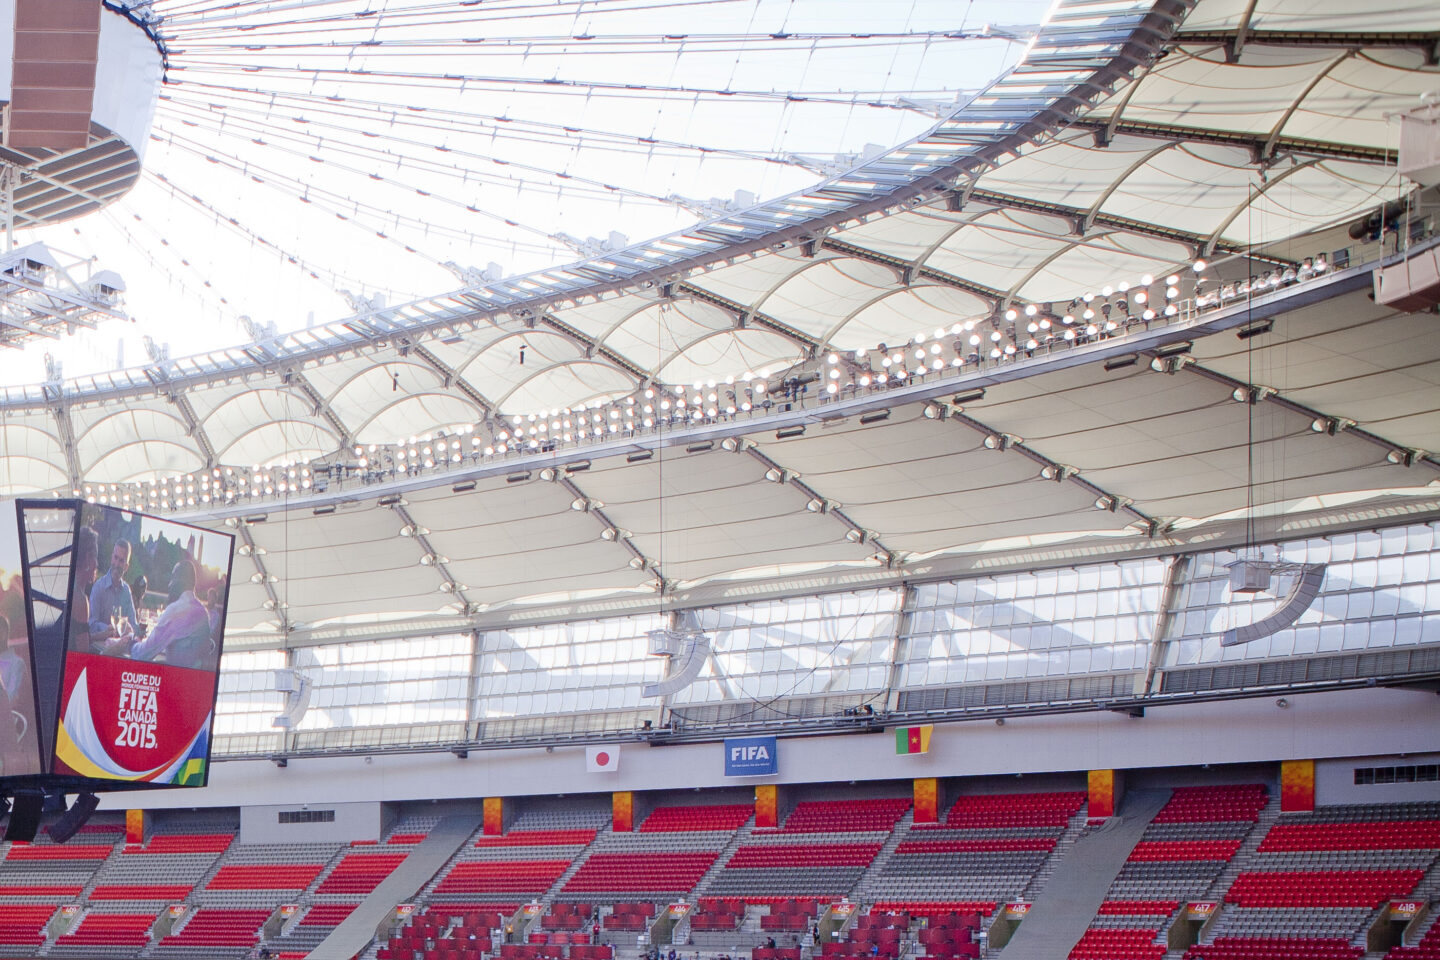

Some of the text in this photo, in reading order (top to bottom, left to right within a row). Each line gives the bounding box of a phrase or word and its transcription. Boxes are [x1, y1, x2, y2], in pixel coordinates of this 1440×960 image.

[122, 672, 161, 687] COUPE DU
[119, 688, 158, 712] FIFA
[118, 708, 157, 724] CANADA
[731, 746, 769, 761] FIFA
[1195, 904, 1210, 912] 417
[1398, 903, 1415, 912] 418
